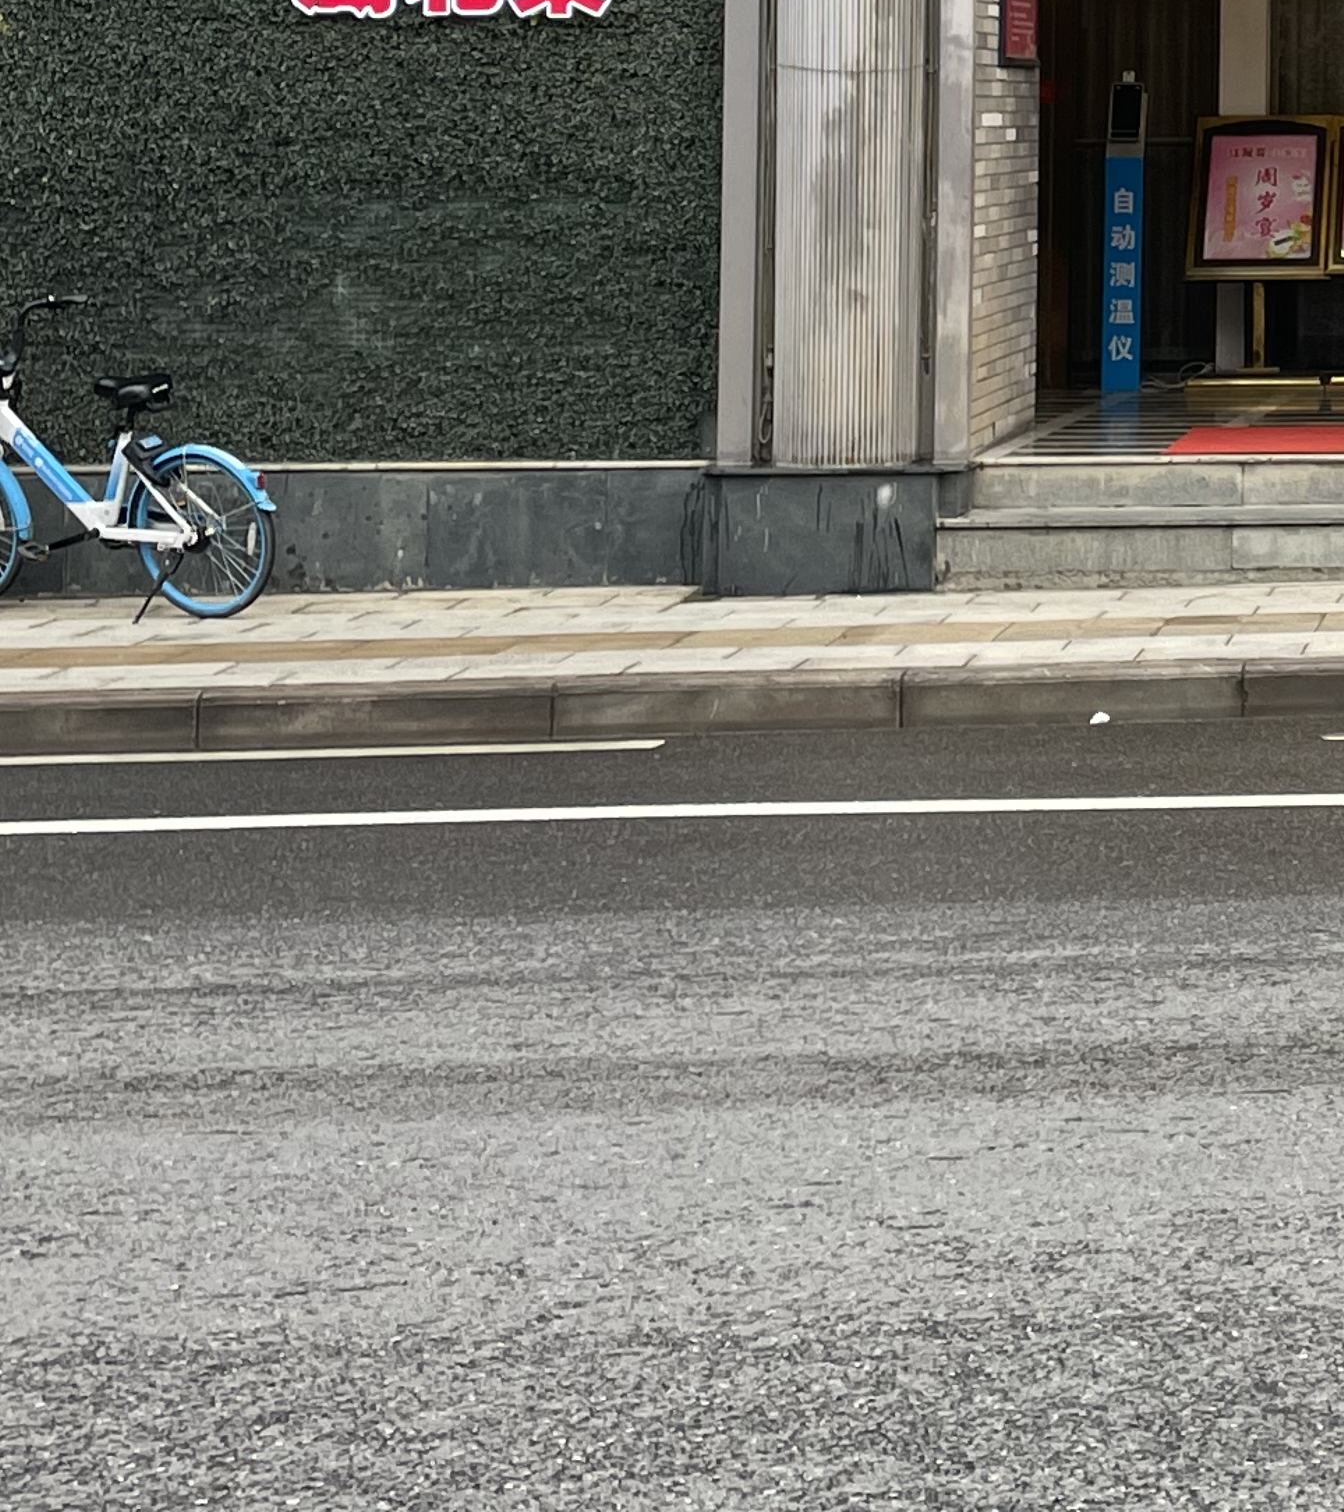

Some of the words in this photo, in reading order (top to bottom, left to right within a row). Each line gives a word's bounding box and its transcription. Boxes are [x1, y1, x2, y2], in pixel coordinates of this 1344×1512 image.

[1254, 167, 1278, 238] 周岁宴
[1108, 188, 1136, 361] 自动测温仪
